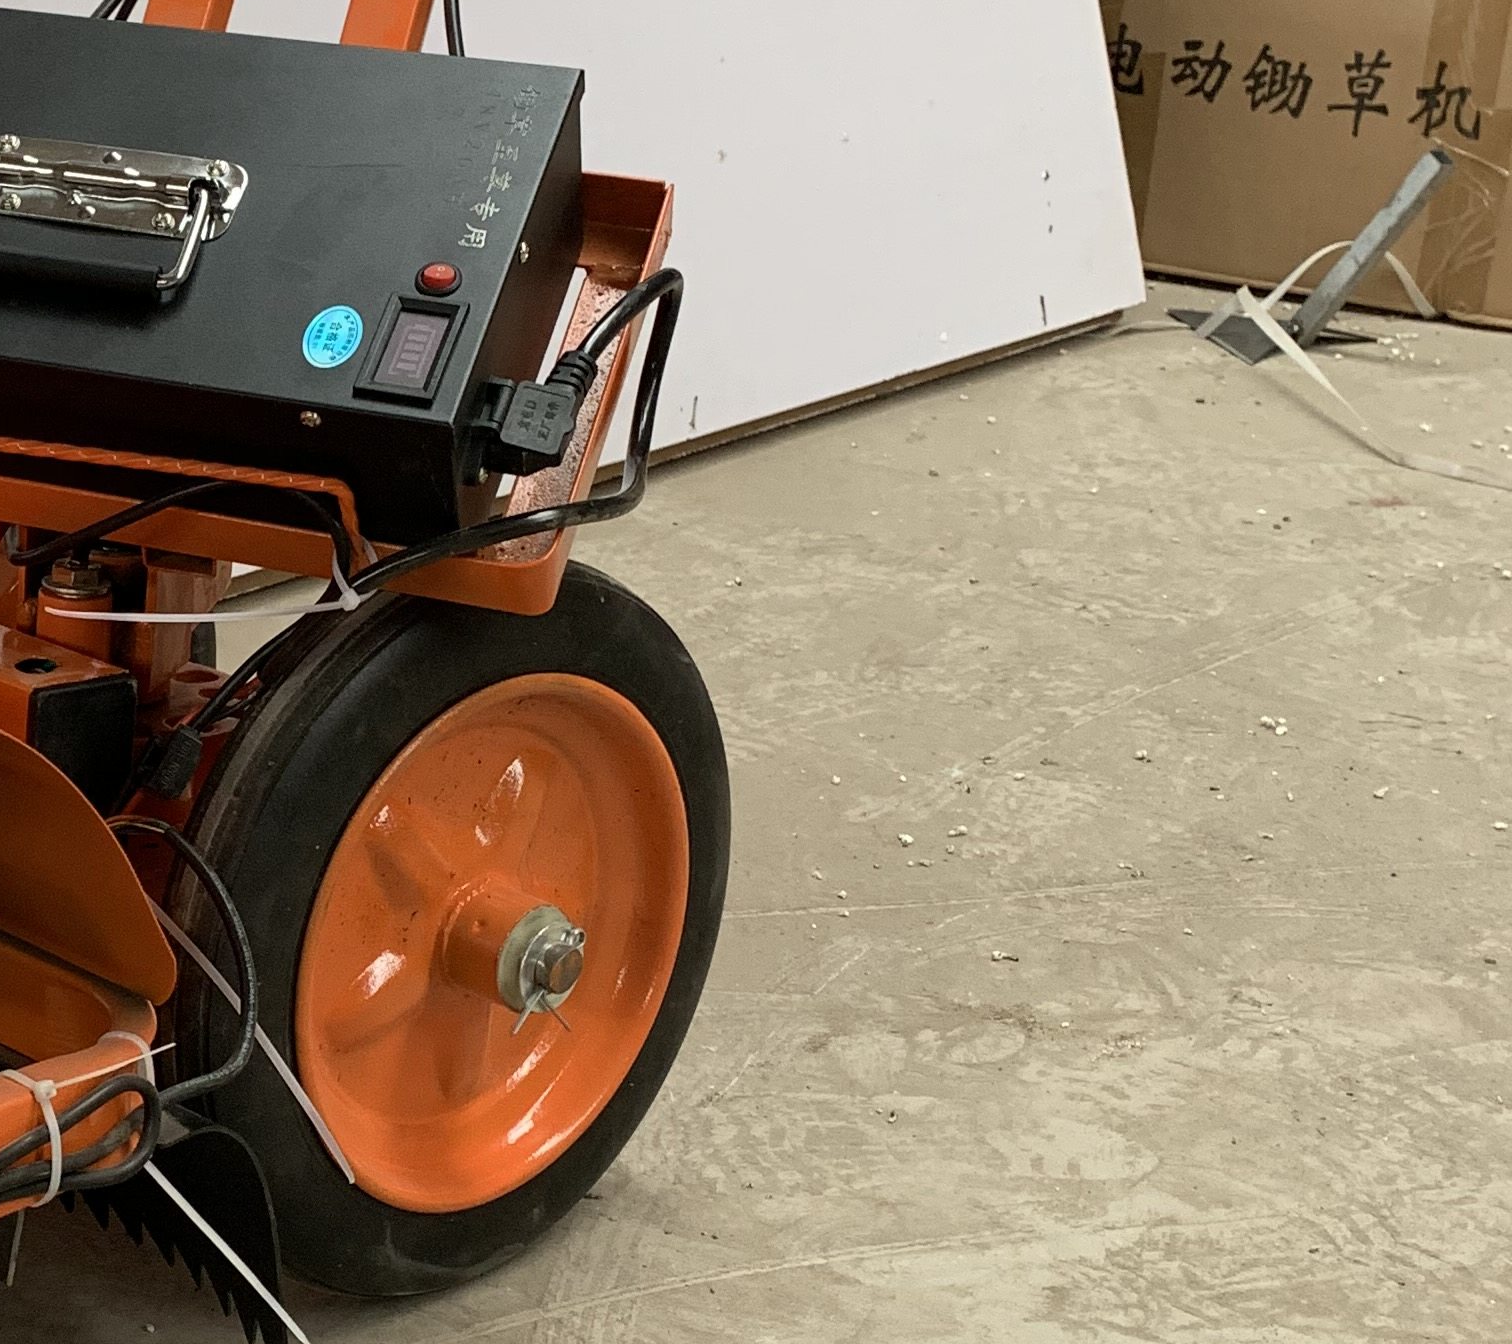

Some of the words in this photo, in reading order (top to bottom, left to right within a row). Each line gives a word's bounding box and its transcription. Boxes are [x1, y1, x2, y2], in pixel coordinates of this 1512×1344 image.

[1108, 23, 1482, 140] 电动锄草机
[322, 321, 343, 352] 合格证
